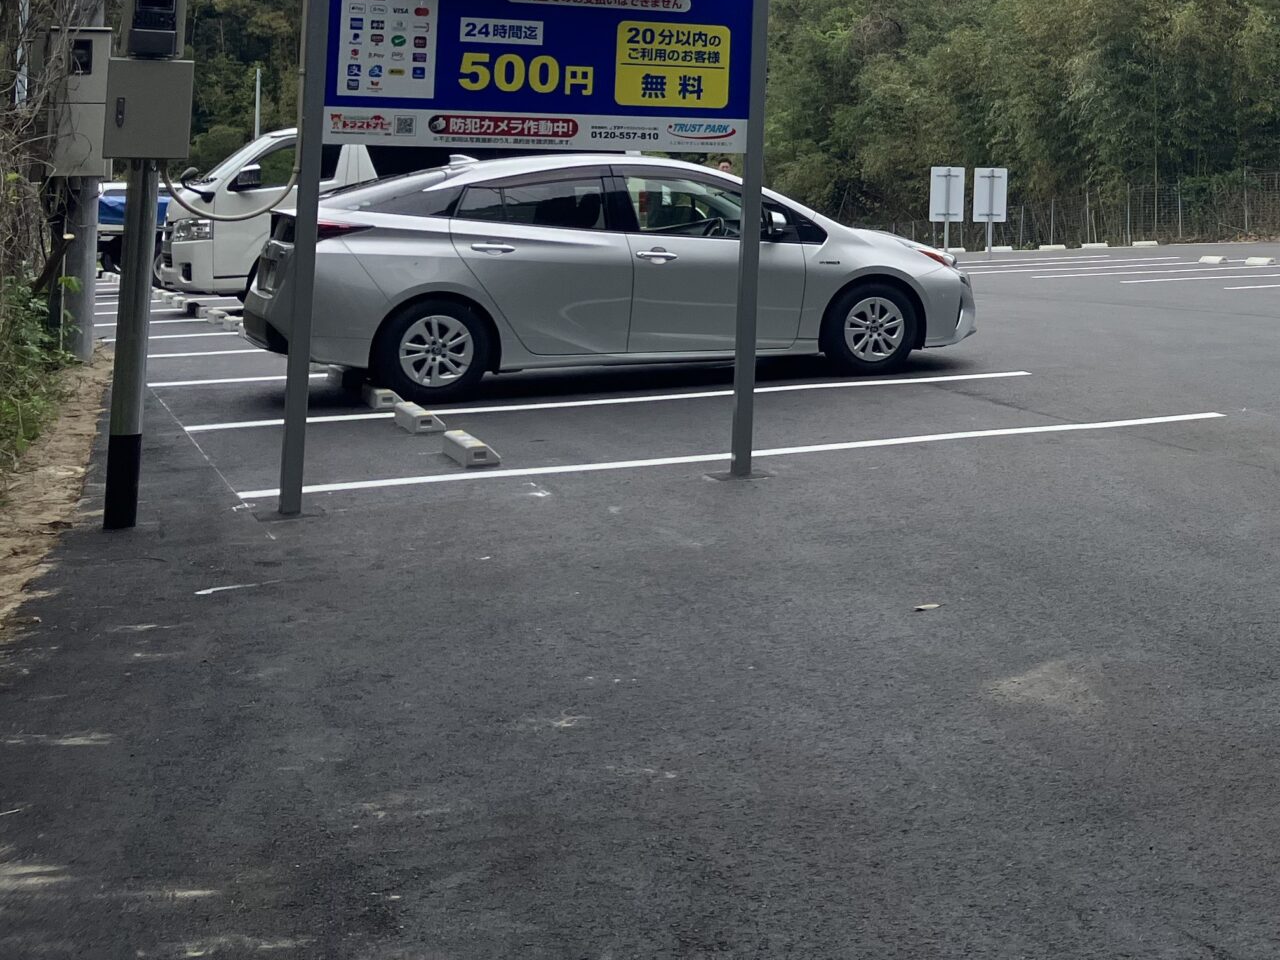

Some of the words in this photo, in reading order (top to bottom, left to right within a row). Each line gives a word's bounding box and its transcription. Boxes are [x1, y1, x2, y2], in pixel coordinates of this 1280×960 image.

[464, 22, 539, 40] 24時間迄
[626, 27, 721, 48] 20分以内の
[627, 47, 721, 64] ご利用のお客様
[458, 52, 594, 96] 500円
[641, 73, 704, 101] 無料
[591, 131, 659, 141] 0120-557-810
[673, 123, 704, 133] TRUST
[703, 124, 730, 133] PARK
